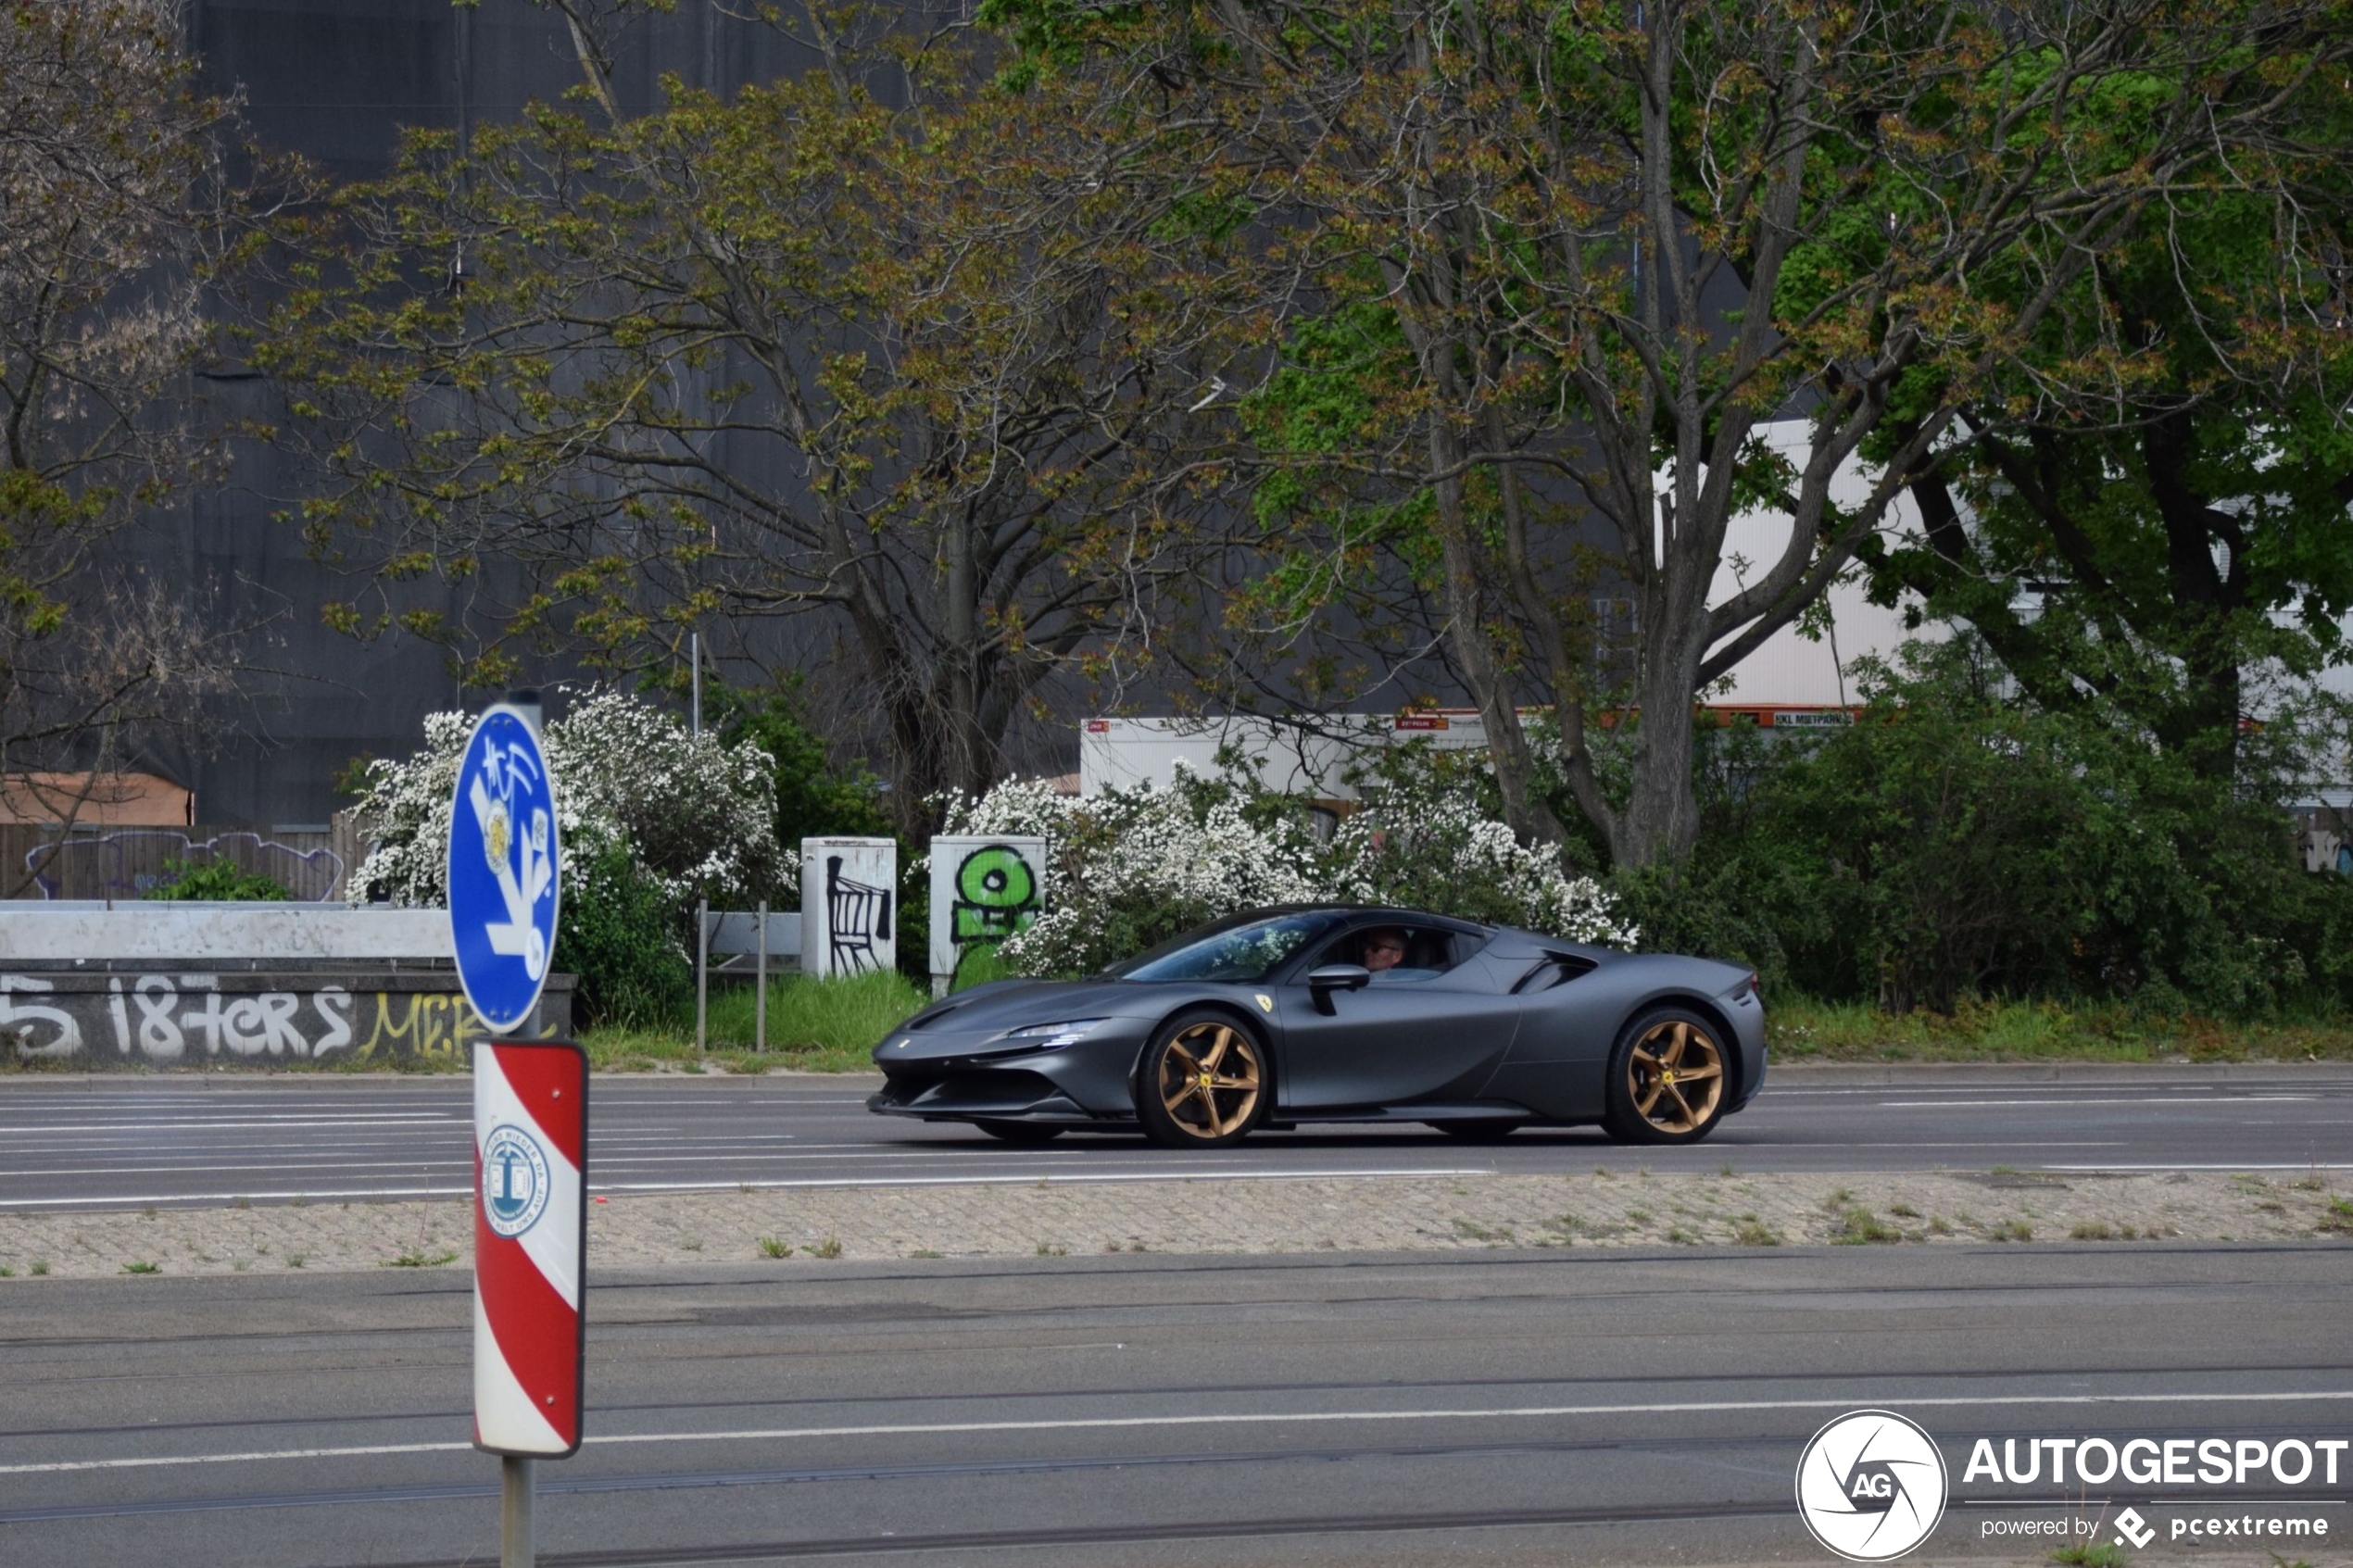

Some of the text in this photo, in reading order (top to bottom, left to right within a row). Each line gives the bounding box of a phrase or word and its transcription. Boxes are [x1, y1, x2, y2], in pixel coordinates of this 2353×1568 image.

[535, 1162, 545, 1179] DA
[515, 1210, 535, 1230] UNS
[533, 1187, 545, 1211] AUF
